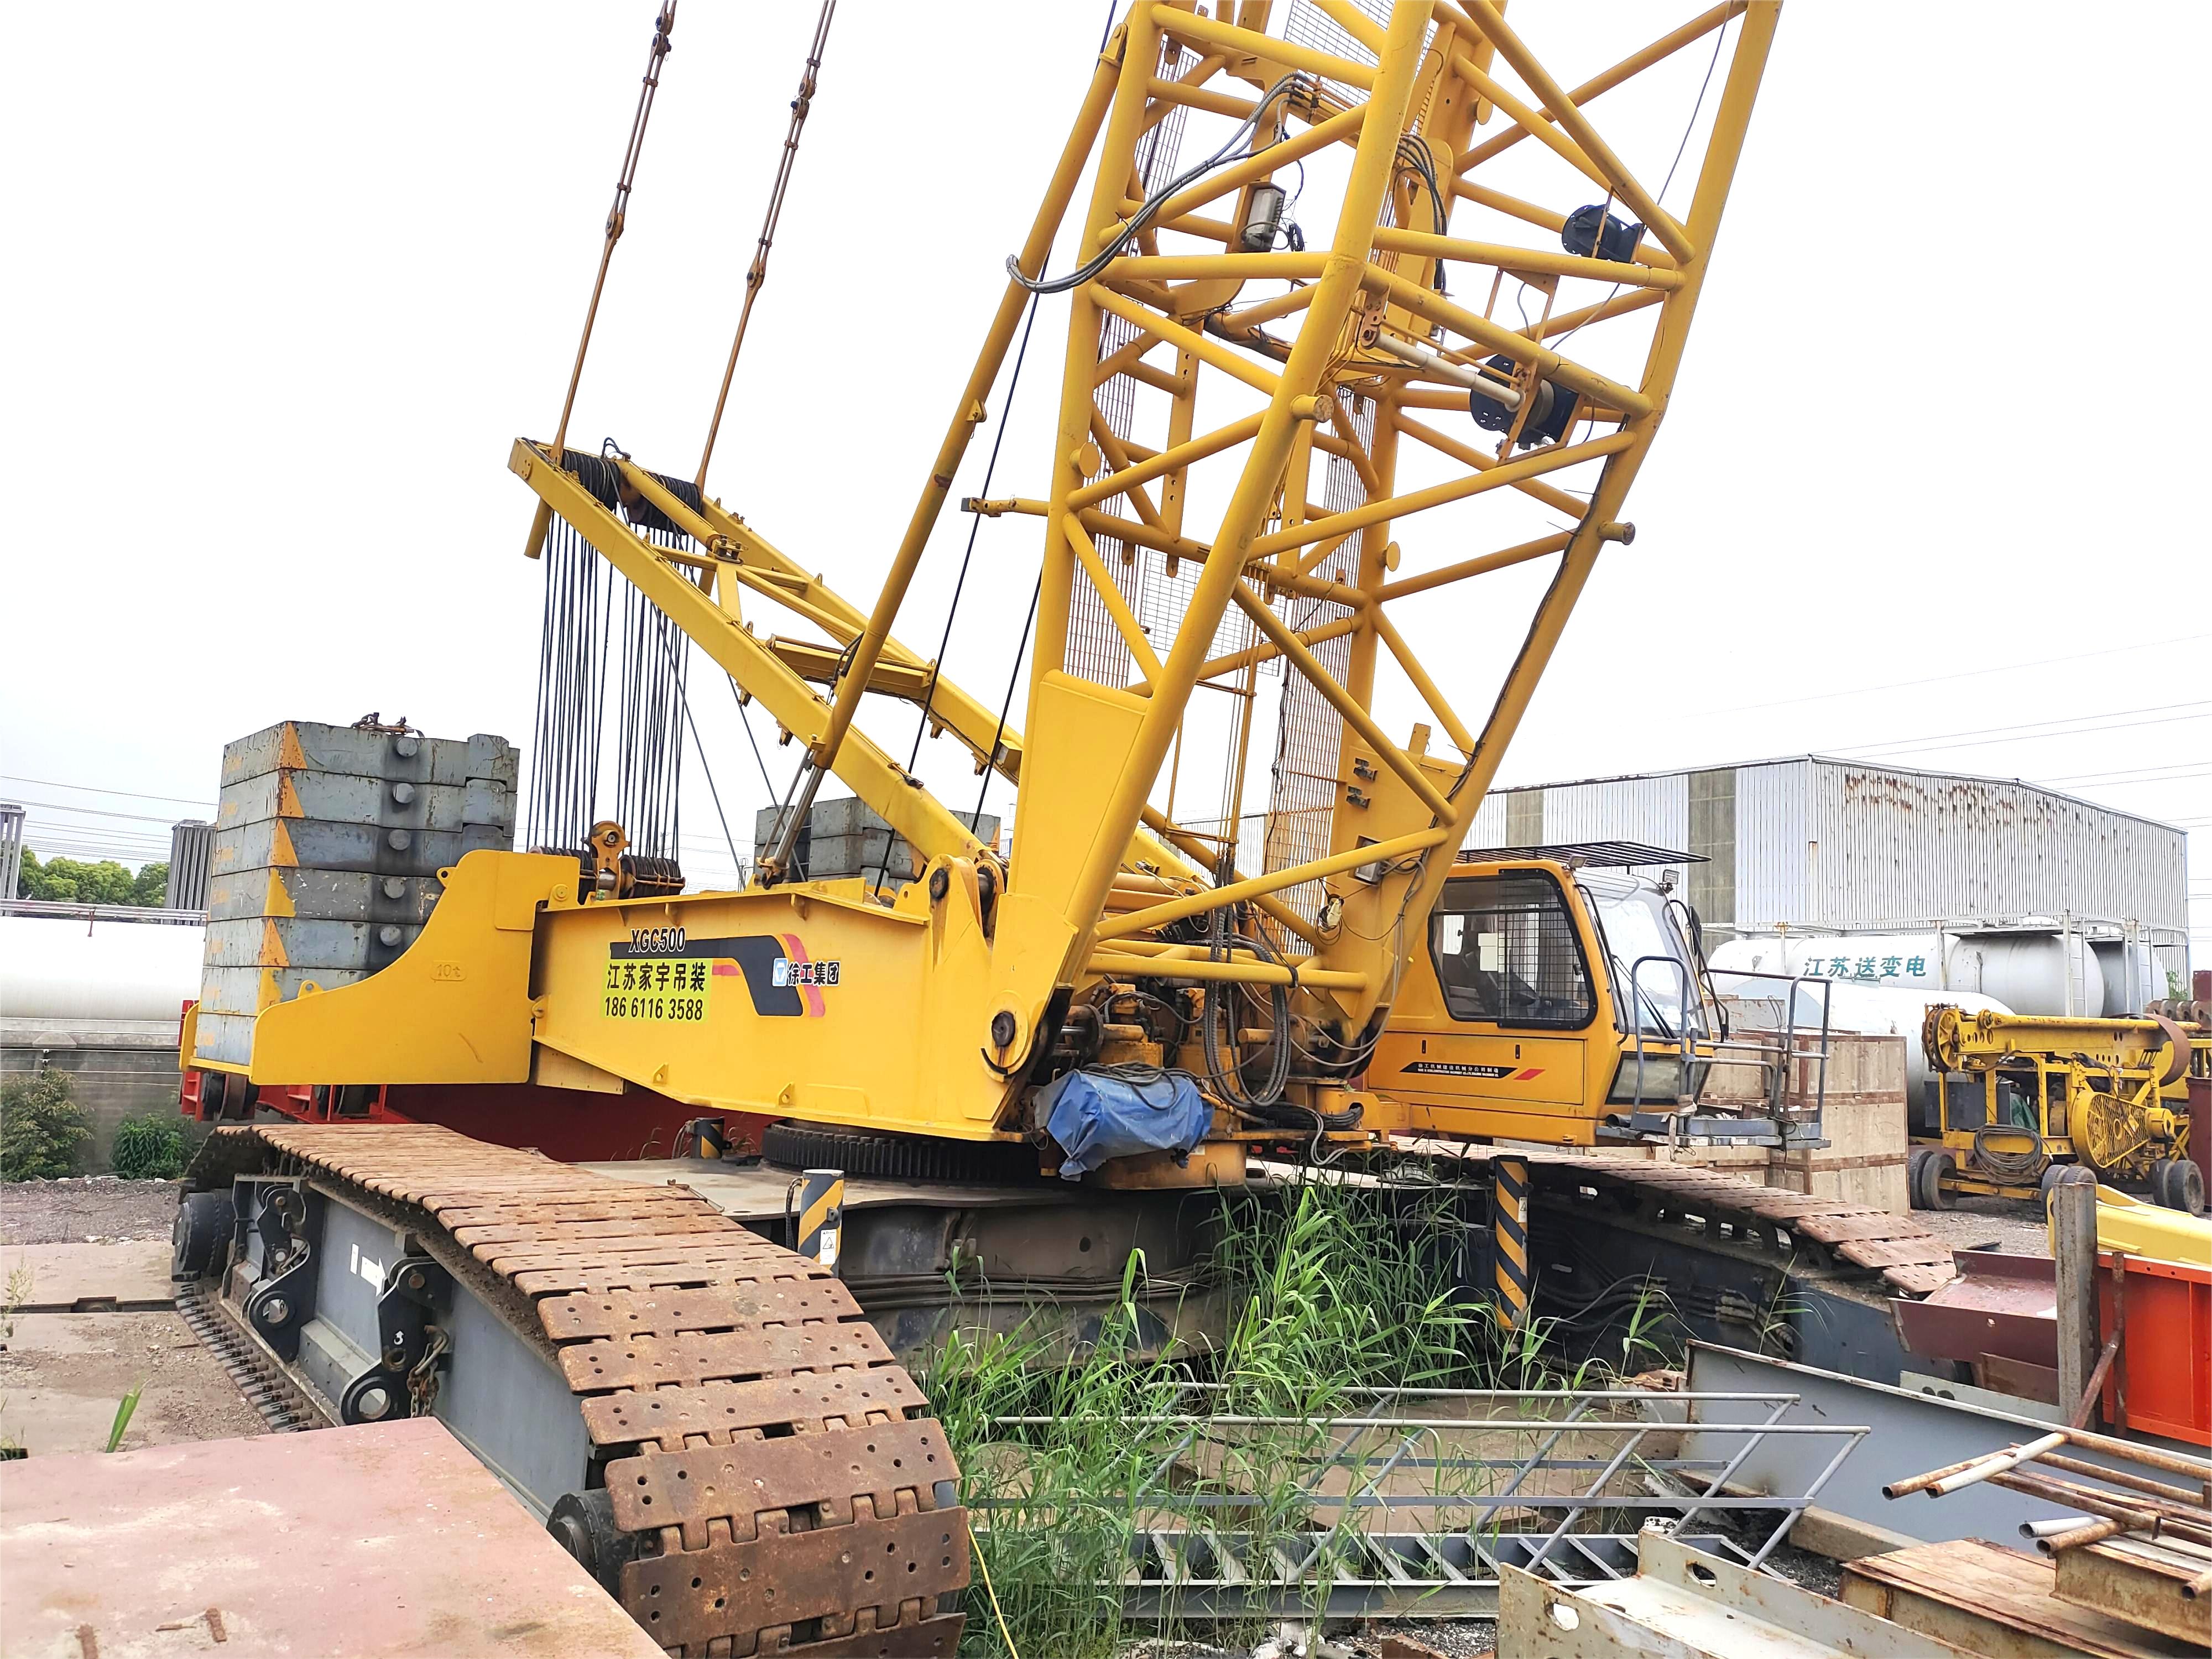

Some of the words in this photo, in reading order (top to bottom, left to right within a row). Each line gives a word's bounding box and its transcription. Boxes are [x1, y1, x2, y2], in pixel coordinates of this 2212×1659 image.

[629, 927, 685, 953] XGC500
[607, 962, 706, 993] 江苏家宇吊装
[787, 961, 840, 986] 徐工集团
[1803, 955, 1927, 978] 江苏送变电
[605, 997, 627, 1018] 186
[631, 998, 663, 1019] 6116
[669, 998, 703, 1021] 3588
